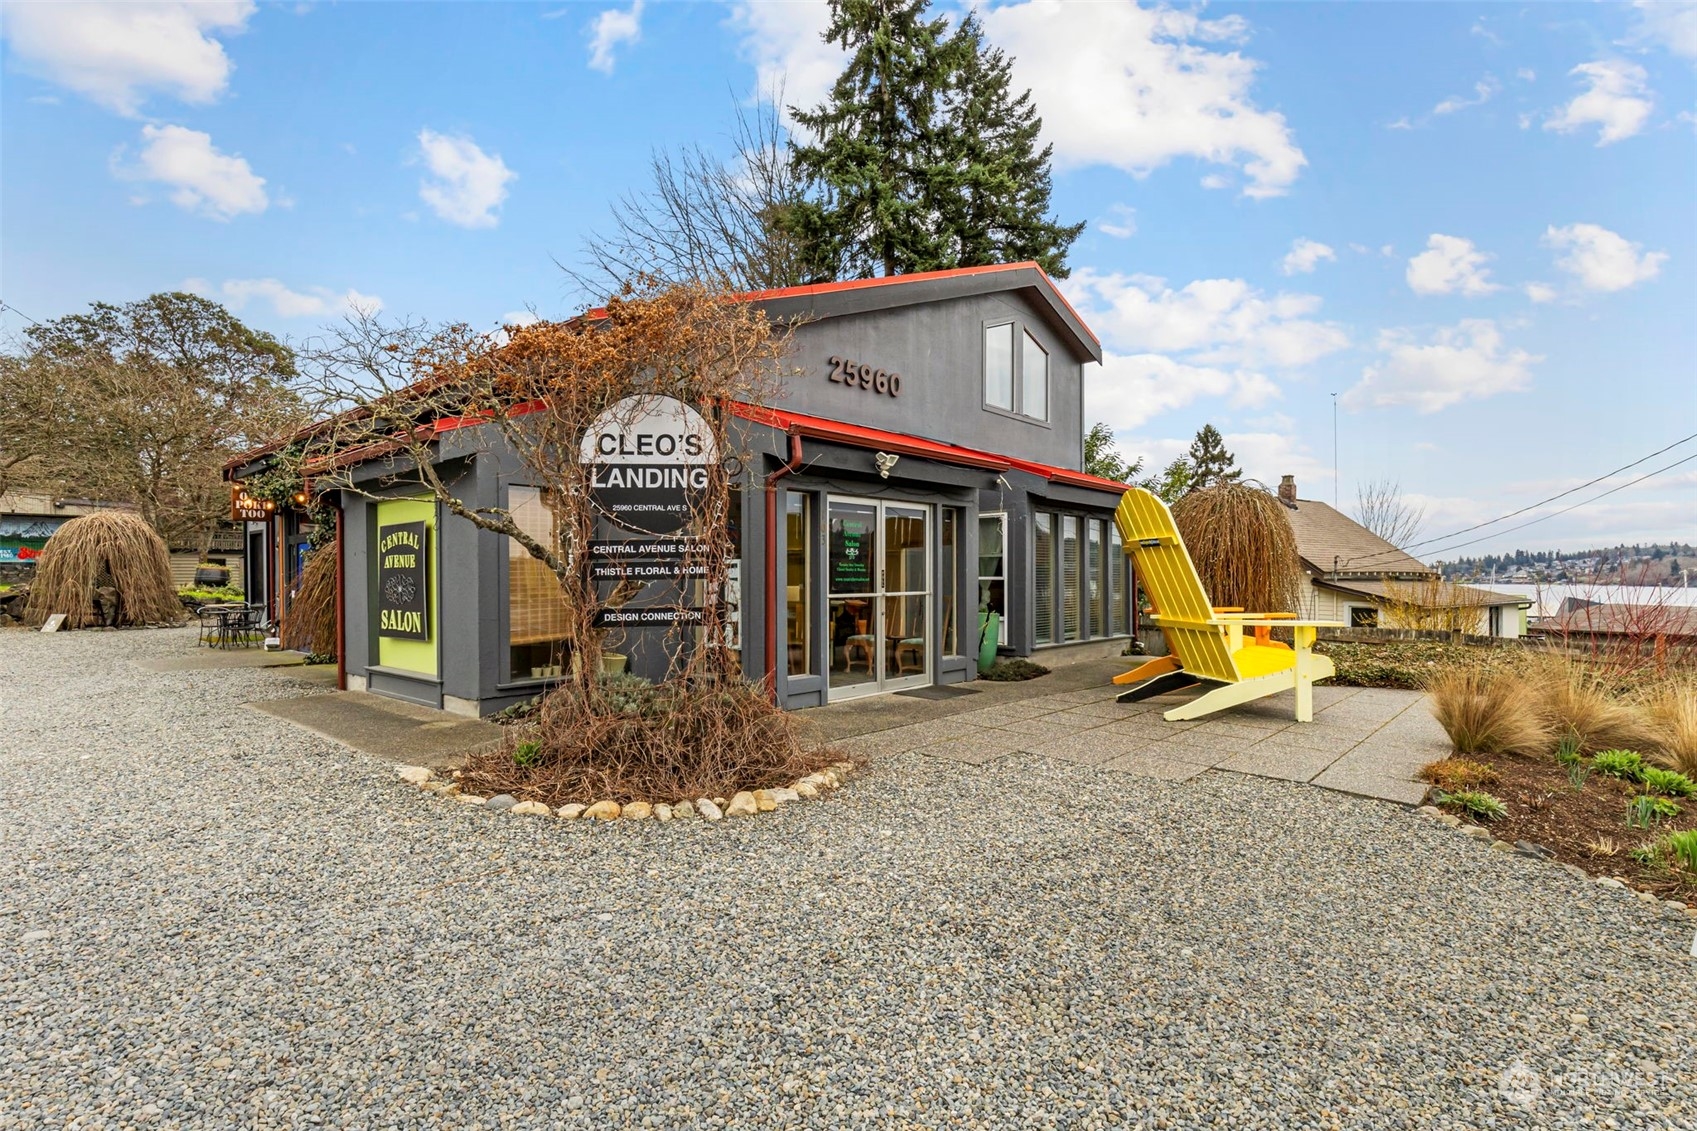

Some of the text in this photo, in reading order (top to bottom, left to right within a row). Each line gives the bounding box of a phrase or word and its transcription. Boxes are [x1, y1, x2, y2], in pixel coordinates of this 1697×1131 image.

[828, 355, 904, 397] 25960
[599, 433, 702, 456] CLEO'S
[592, 467, 708, 488] LANDING
[240, 509, 265, 518] TOO
[612, 504, 633, 512] 25960
[633, 504, 666, 512] CENTRAL
[381, 531, 420, 553] CENTRAL
[593, 544, 710, 554] CENTRAL AVENUE SALON
[384, 554, 416, 569] AVENUE
[595, 566, 709, 576] THISTLE FLORAL & HOME
[381, 609, 421, 633] SALON
[604, 613, 639, 622] DESIGN
